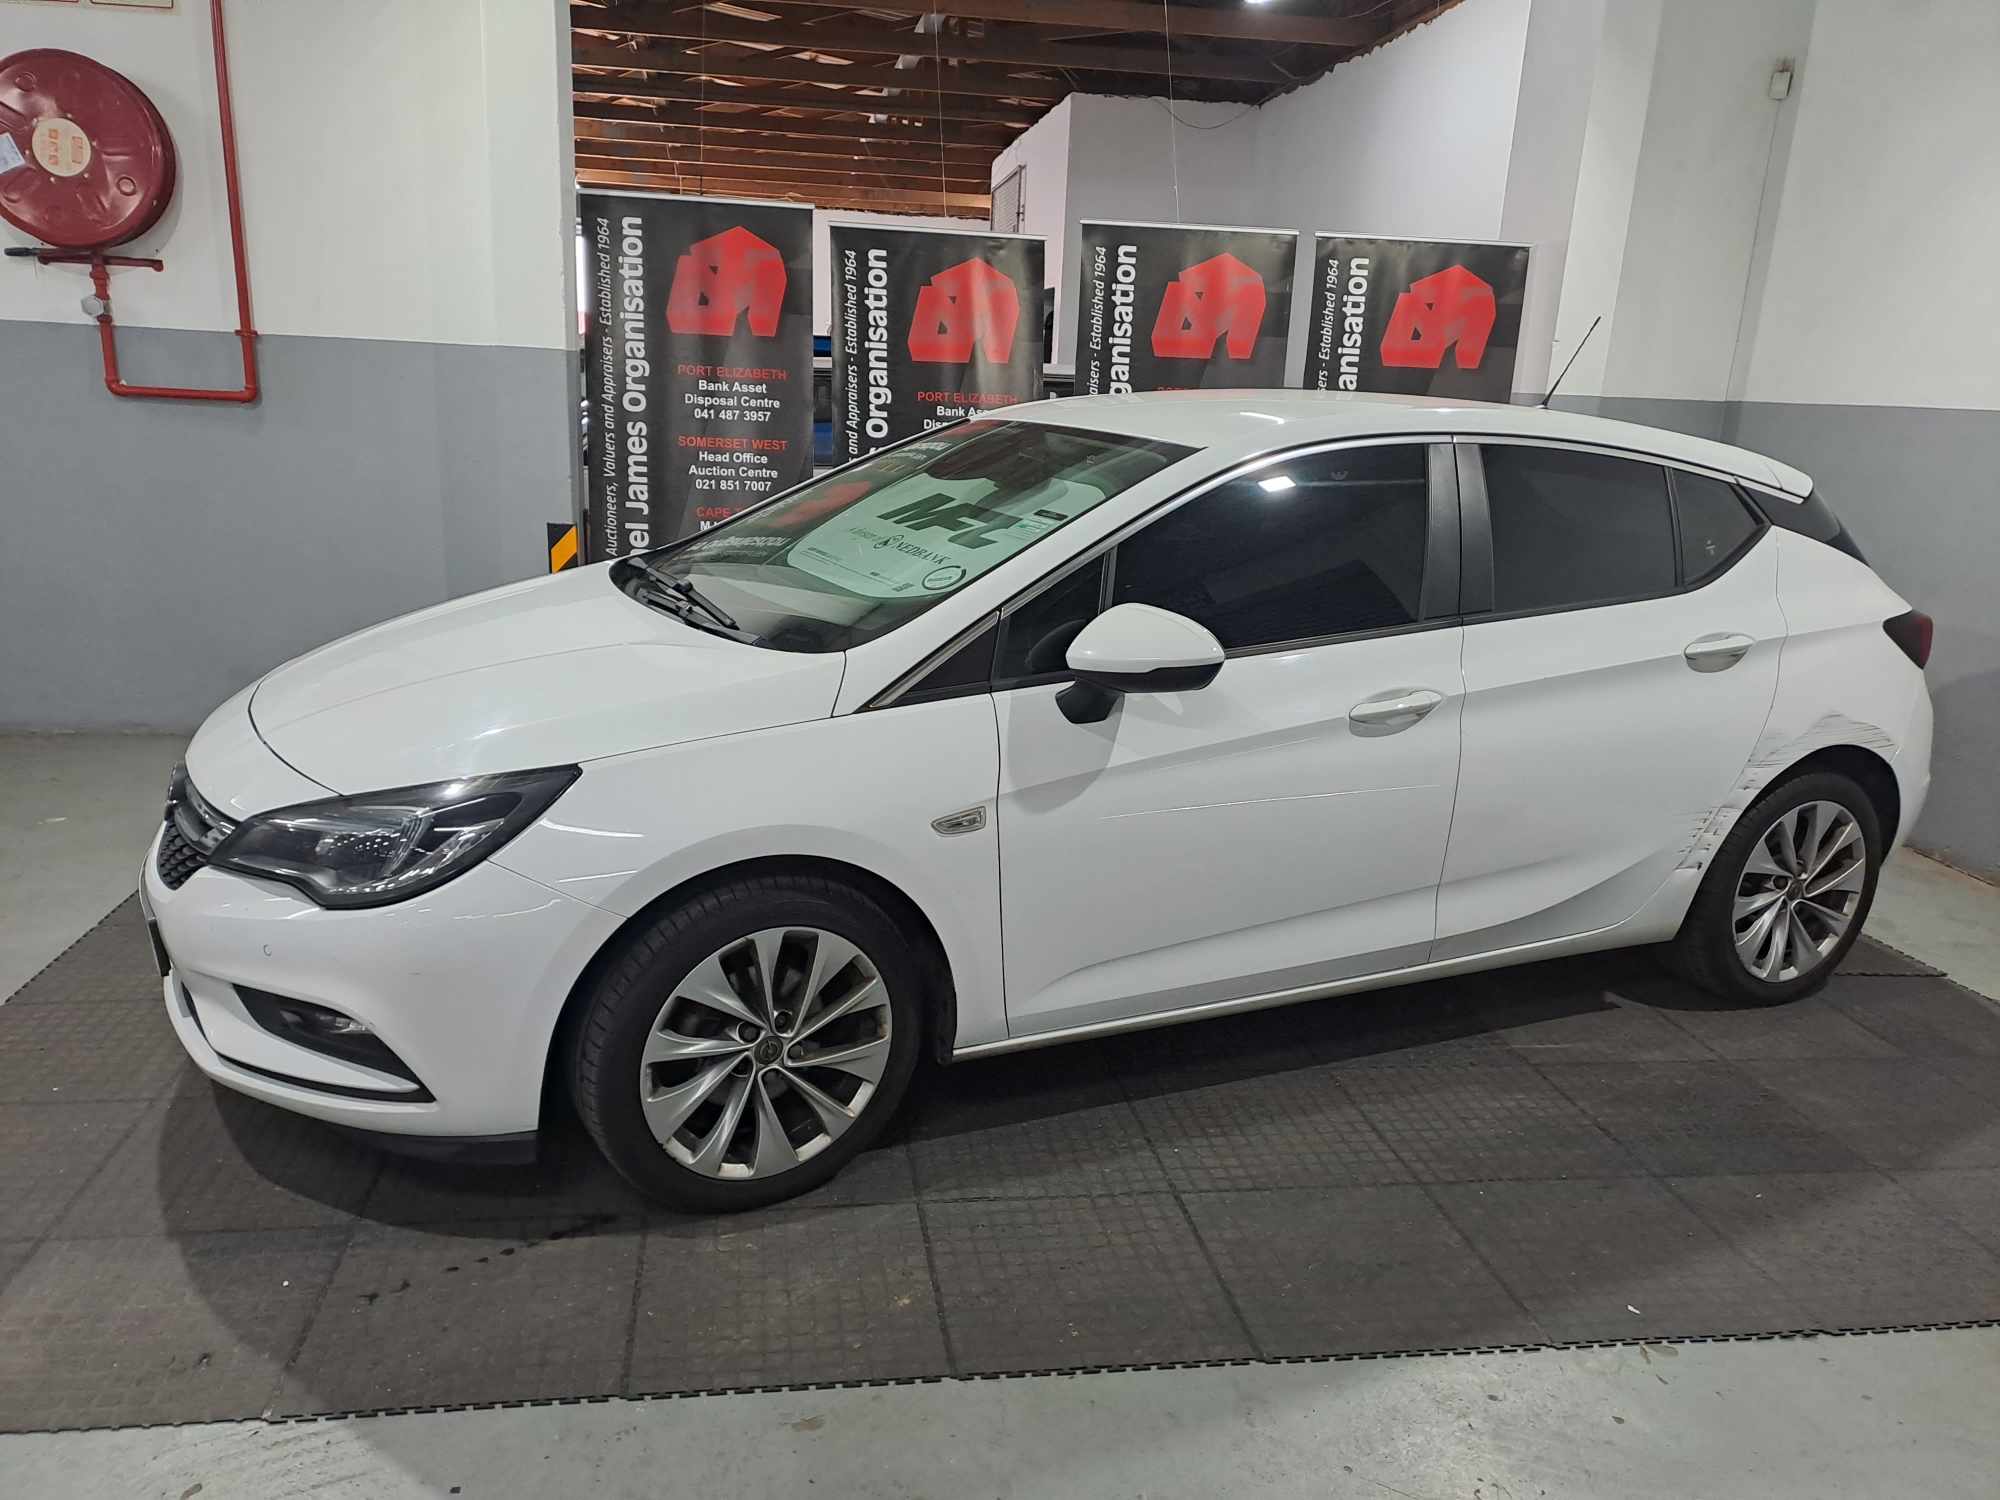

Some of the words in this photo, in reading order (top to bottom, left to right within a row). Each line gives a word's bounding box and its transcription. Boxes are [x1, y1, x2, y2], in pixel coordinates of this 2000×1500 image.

[597, 217, 609, 248] 1964
[845, 249, 857, 280] 1964
[1094, 246, 1106, 277] 1964
[1326, 259, 1339, 288] 1964
[598, 252, 612, 325] Established
[618, 216, 650, 412] Organisation
[844, 282, 857, 355] Established
[1090, 279, 1104, 350] Established
[1319, 292, 1336, 360] Established
[864, 249, 891, 438] Organisation
[601, 336, 616, 402] Appraisers
[677, 364, 712, 376] PORT
[717, 366, 787, 379] ELIZABETH
[685, 393, 737, 407] Disposal
[740, 396, 780, 408] Centre
[698, 379, 729, 391] Bank
[732, 382, 767, 393] Asset
[845, 364, 860, 430] Appraisers
[917, 391, 950, 402] PORT
[953, 392, 1017, 404] ELIZABETH
[602, 403, 614, 430] and
[694, 408, 715, 419] 041
[718, 409, 739, 420] 487
[743, 411, 771, 421] 3957
[936, 406, 965, 417] Bank
[603, 432, 616, 477] Valuers
[678, 436, 747, 449] SOMERSET
[751, 439, 788, 450] WEST
[699, 451, 729, 462] Head
[733, 452, 768, 464] Office
[845, 431, 858, 455] and
[625, 421, 649, 515] James
[689, 465, 735, 476] Auction
[739, 466, 778, 478] Centre
[695, 479, 715, 490] 021
[720, 480, 740, 490] 851
[744, 481, 772, 492] 7007
[605, 482, 618, 556] Auctioneers,
[696, 506, 730, 518] CAPE
[895, 541, 952, 565] NEDBANK
